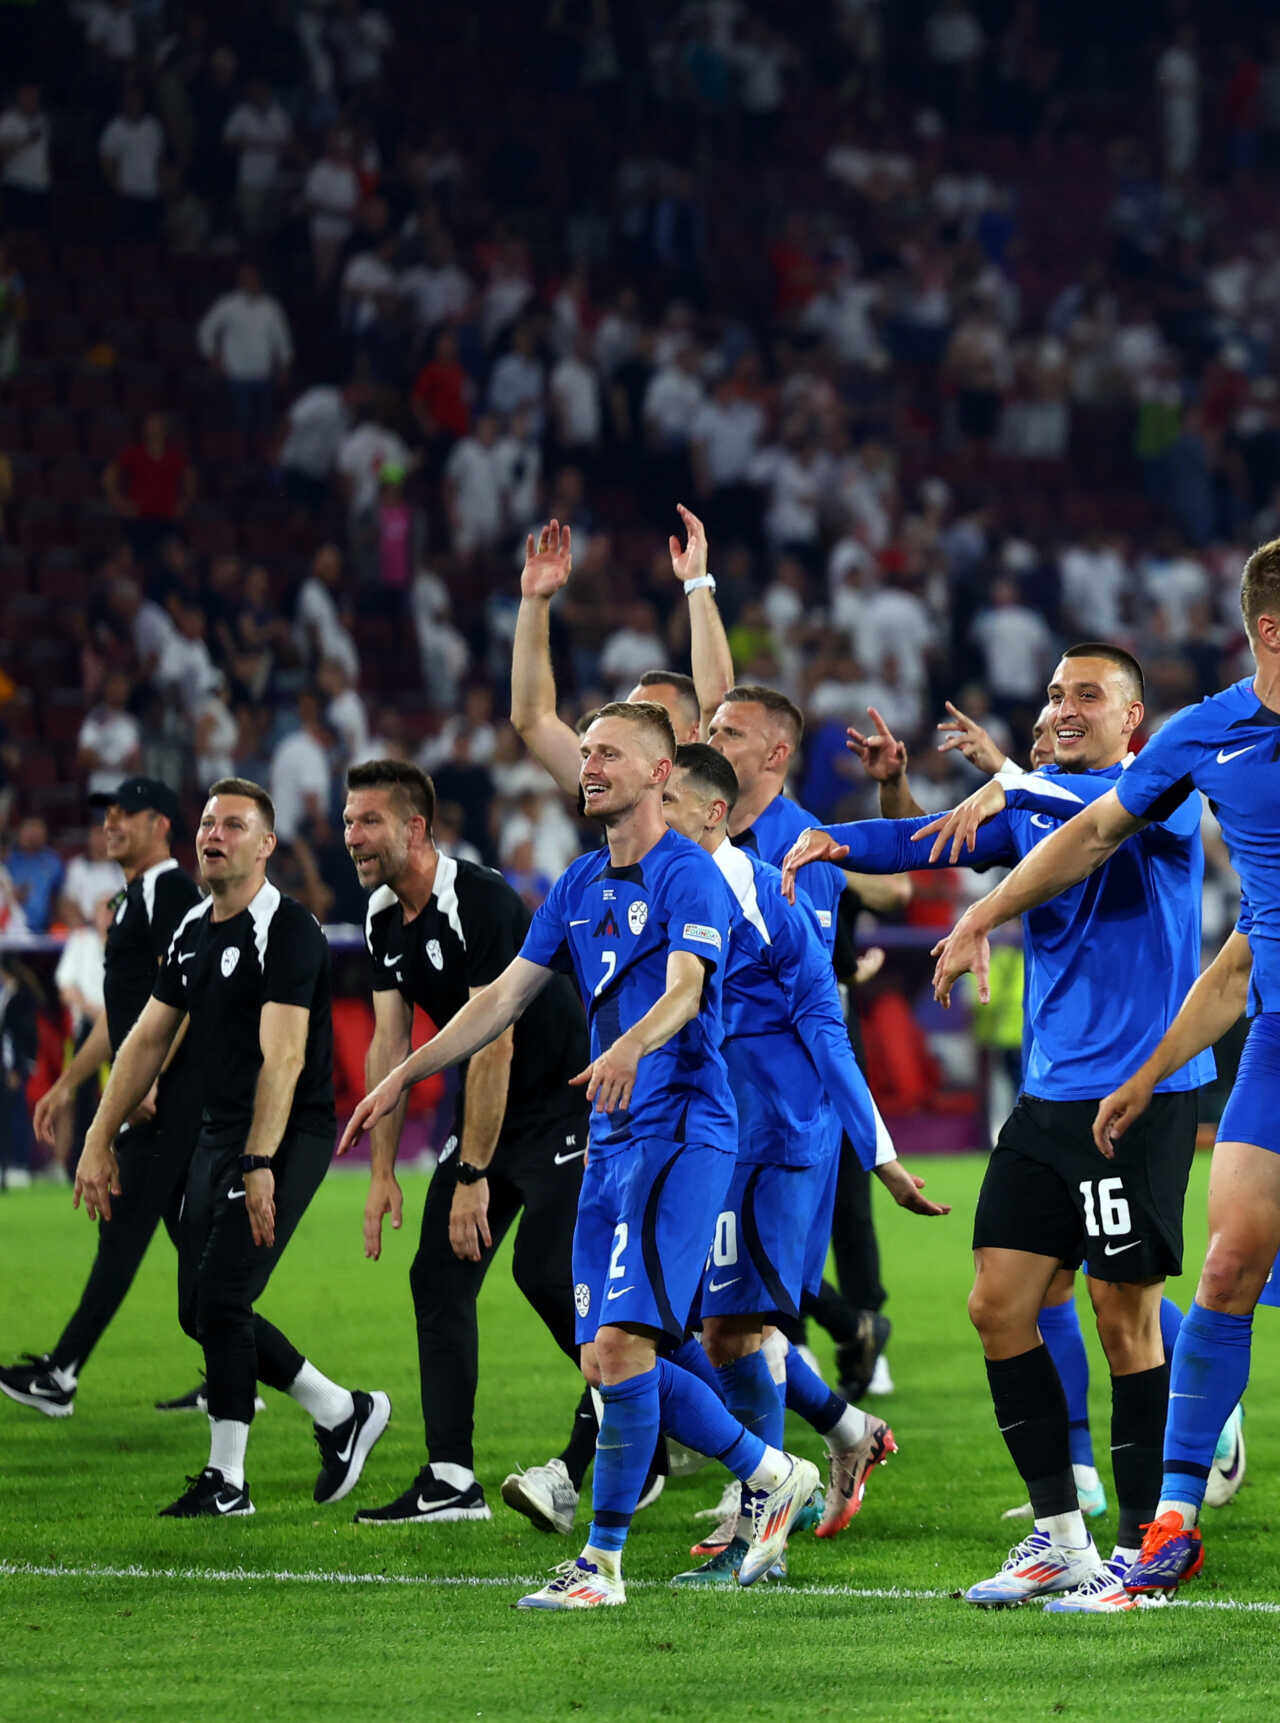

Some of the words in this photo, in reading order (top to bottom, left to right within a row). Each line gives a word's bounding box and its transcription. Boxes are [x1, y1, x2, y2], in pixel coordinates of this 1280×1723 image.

[1079, 1177, 1132, 1237] 16
[609, 1222, 629, 1280] 2
[705, 1211, 738, 1273] 0
